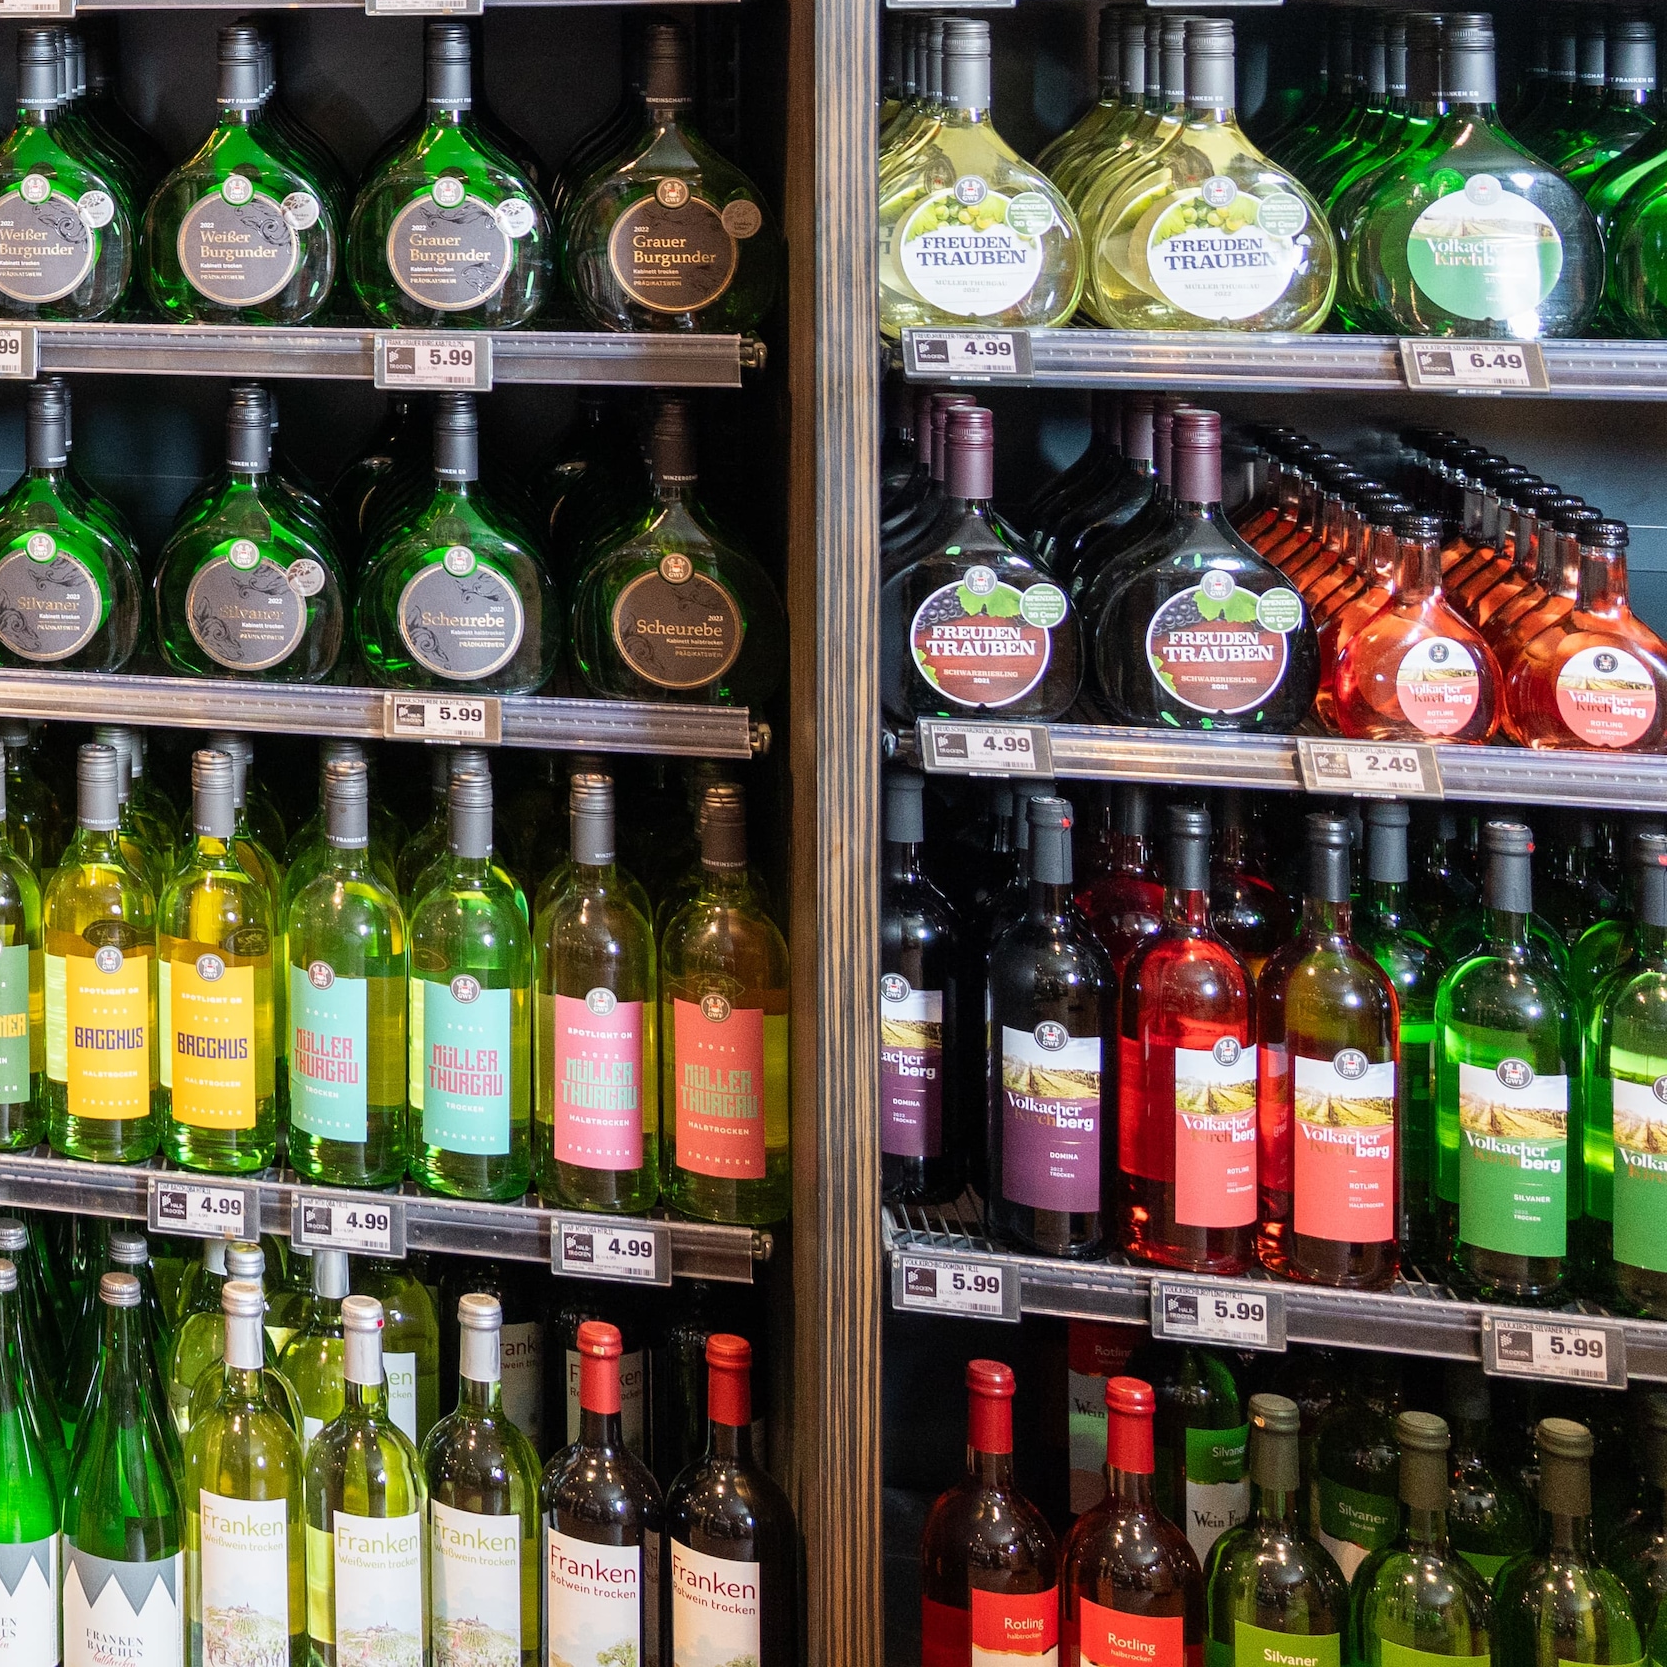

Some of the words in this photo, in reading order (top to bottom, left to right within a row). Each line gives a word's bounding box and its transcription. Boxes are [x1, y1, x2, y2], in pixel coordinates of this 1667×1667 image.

[0, 229, 48, 243] Weißer
[409, 233, 462, 248] Grauer
[921, 236, 1012, 250] FREUDEN
[0, 244, 74, 260] Burgunder
[409, 247, 491, 265] Burgunder
[916, 250, 1026, 266] TRAUBEN
[1470, 352, 1522, 369] 6.49
[636, 620, 723, 638] Scheurebe
[932, 625, 1021, 641] FREUDEN
[926, 640, 1037, 657] TRAUBEN
[943, 670, 1019, 679] SCHWARZRIESLING
[1568, 690, 1635, 707] Volkacher
[1366, 755, 1418, 773] 2.49
[74, 1026, 143, 1052] BACCHUS
[566, 1055, 633, 1085] MÜLLER
[562, 1078, 637, 1111] THURGAU
[1049, 1151, 1079, 1161] DOMINA
[1513, 1193, 1552, 1205] SILVANER
[608, 1238, 653, 1259] 4.99
[951, 1274, 1001, 1294] 5.99
[201, 1506, 284, 1538] Franken
[203, 1532, 243, 1549] Weißwein
[245, 1540, 284, 1553] trocken
[550, 1546, 637, 1584] Franken
[550, 1569, 592, 1592] Rotwein
[595, 1583, 637, 1600] trocken
[1107, 1630, 1157, 1655] Rotling
